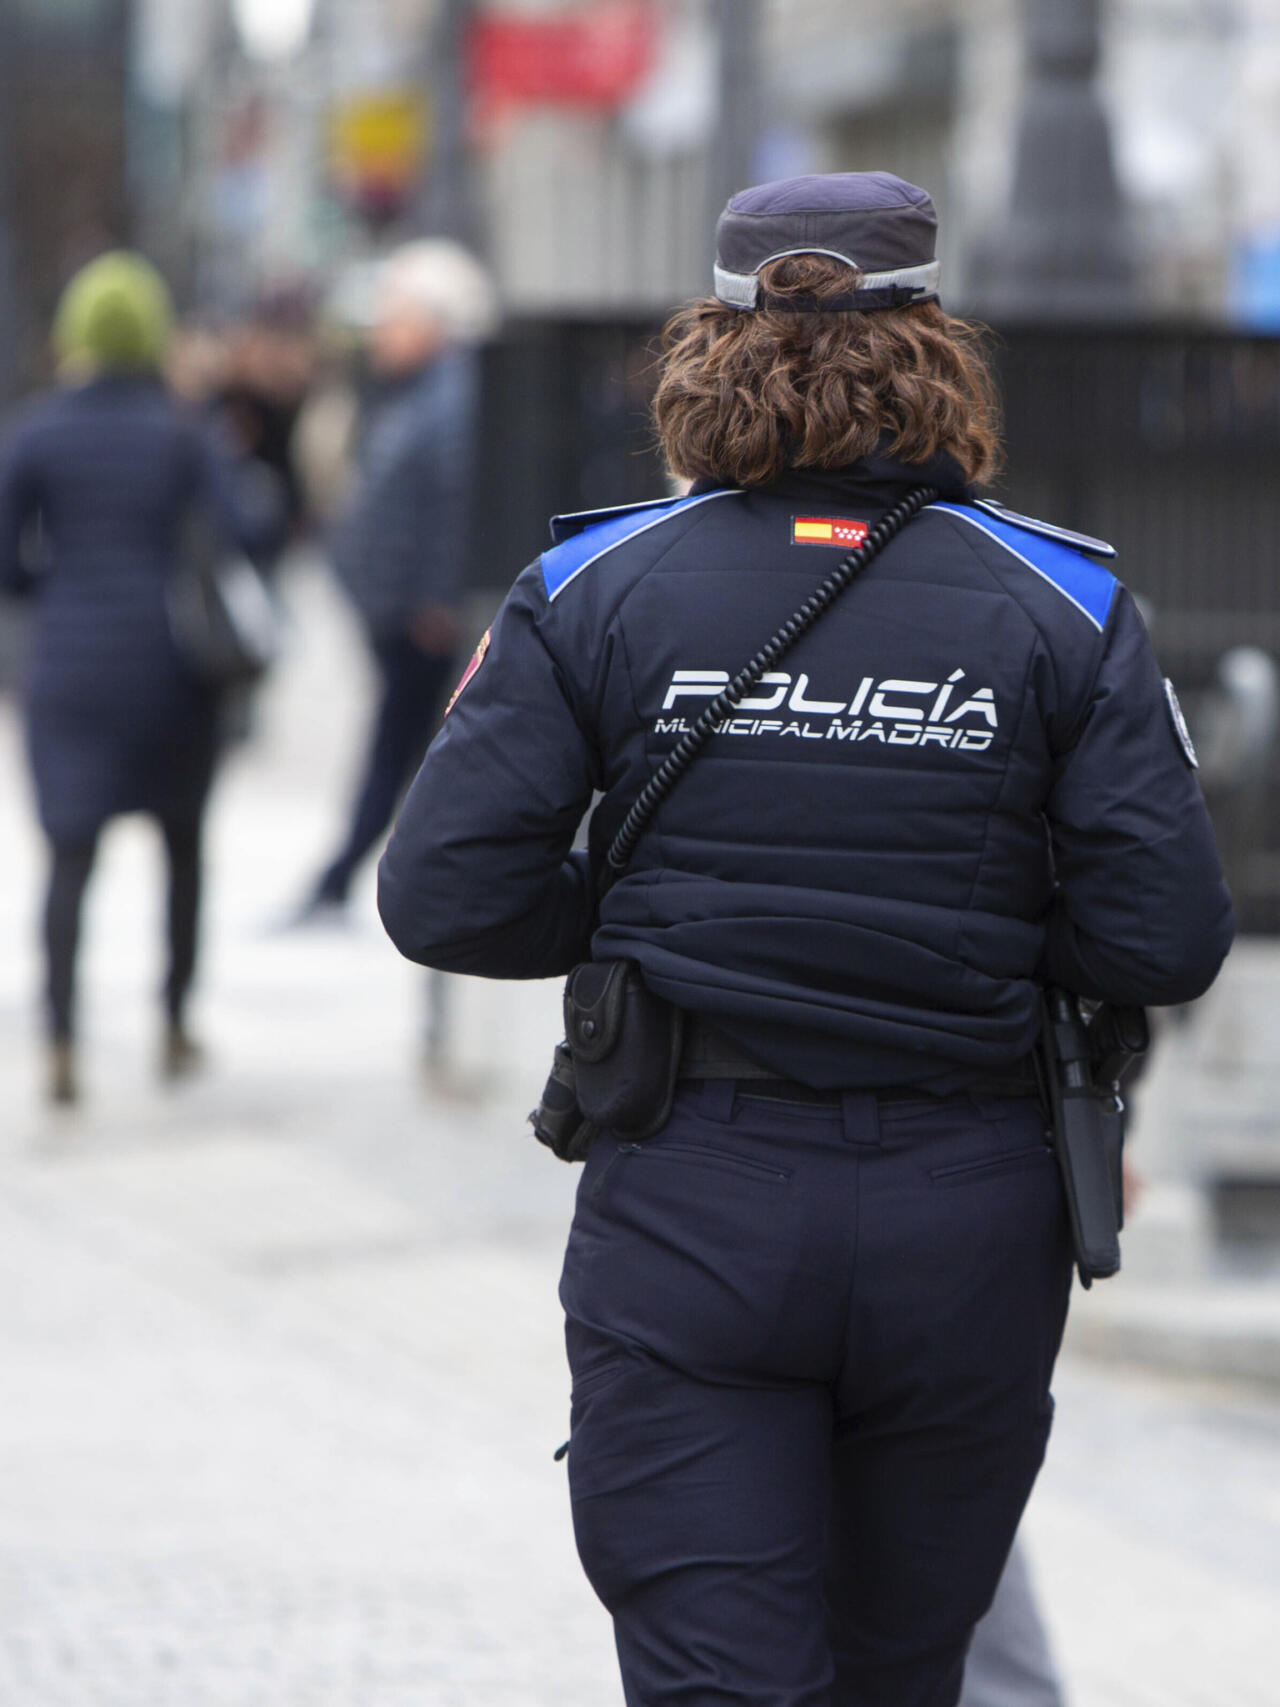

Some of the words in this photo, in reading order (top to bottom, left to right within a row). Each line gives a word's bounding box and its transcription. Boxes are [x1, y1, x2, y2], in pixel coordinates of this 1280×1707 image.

[662, 668, 998, 728] POLICÍA
[654, 718, 824, 738] MICIPAL
[825, 719, 995, 751] MADRID
